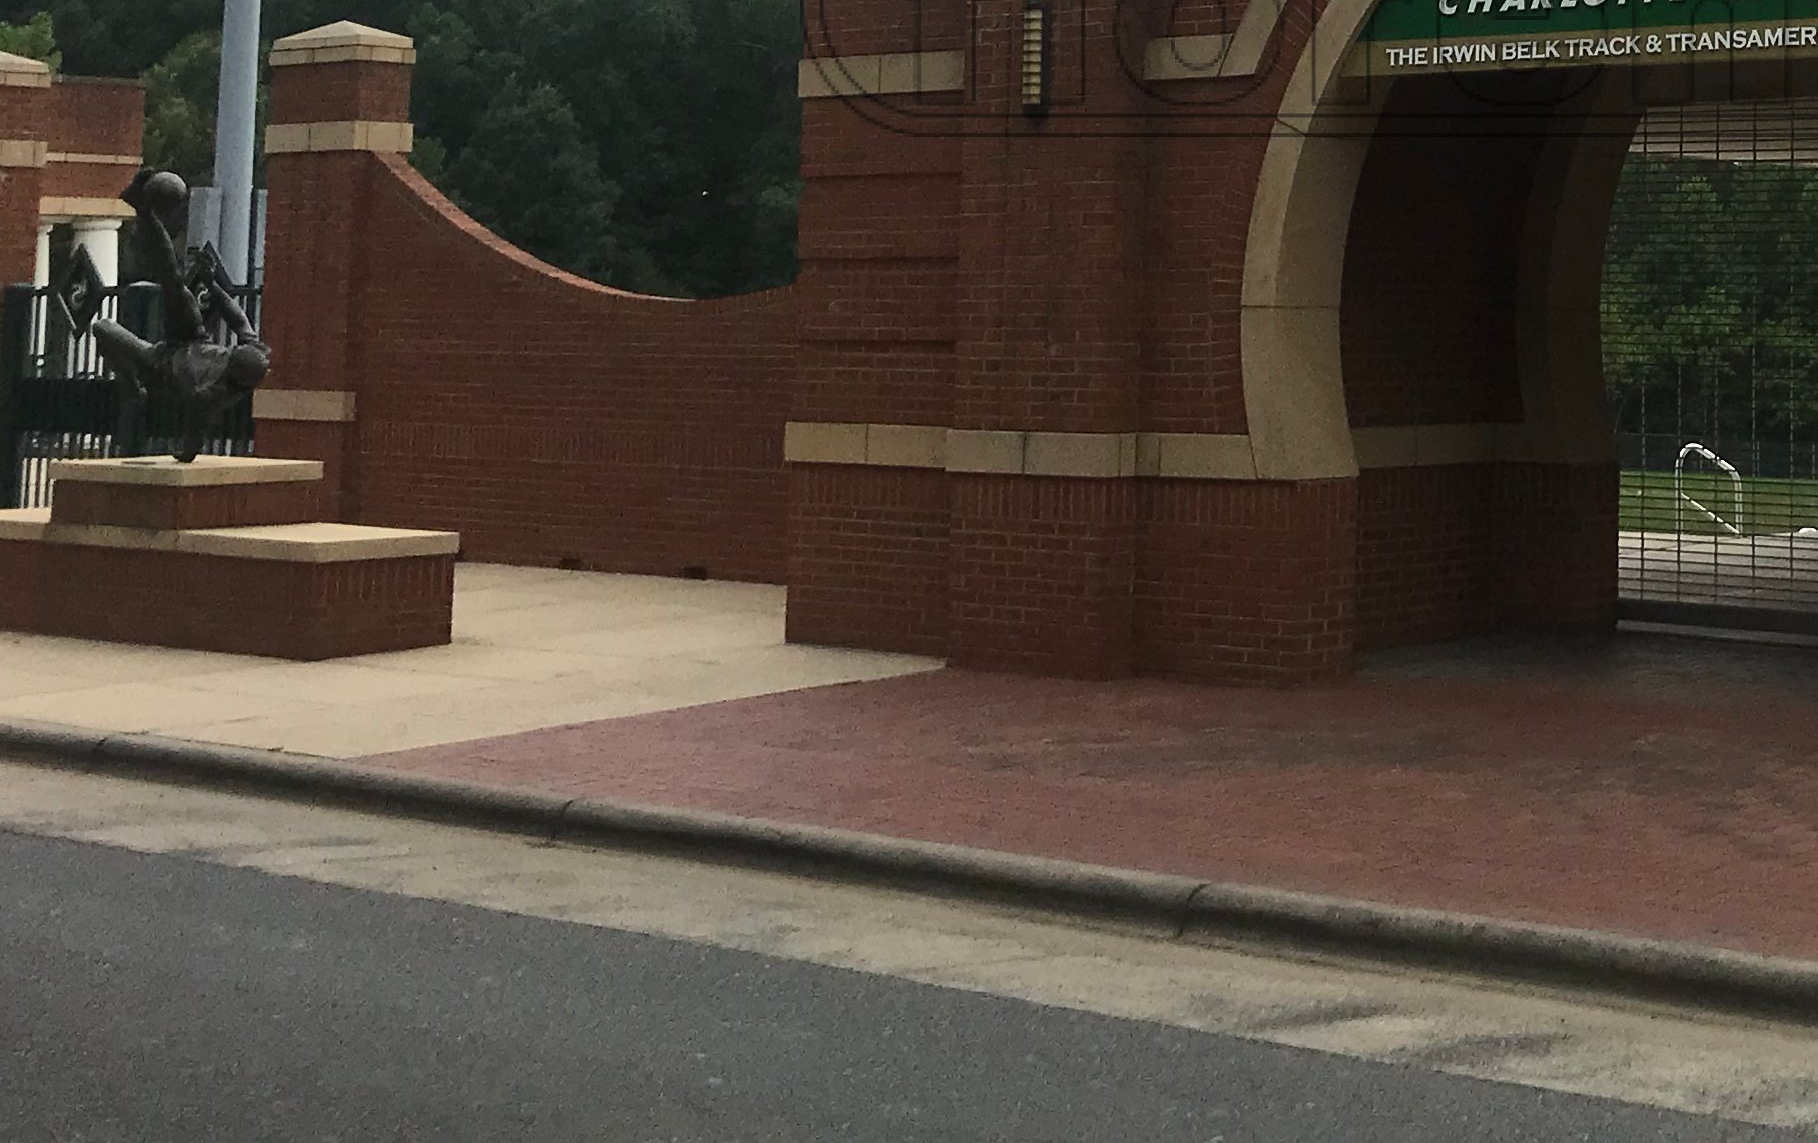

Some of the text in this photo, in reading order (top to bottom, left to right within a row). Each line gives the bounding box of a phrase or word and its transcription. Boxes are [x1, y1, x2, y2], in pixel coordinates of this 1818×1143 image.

[1385, 46, 1428, 66] THE
[1432, 42, 1497, 65] IRWIN
[1501, 38, 1559, 61] BELK
[1564, 34, 1641, 58] TRACK
[1645, 33, 1663, 54] &
